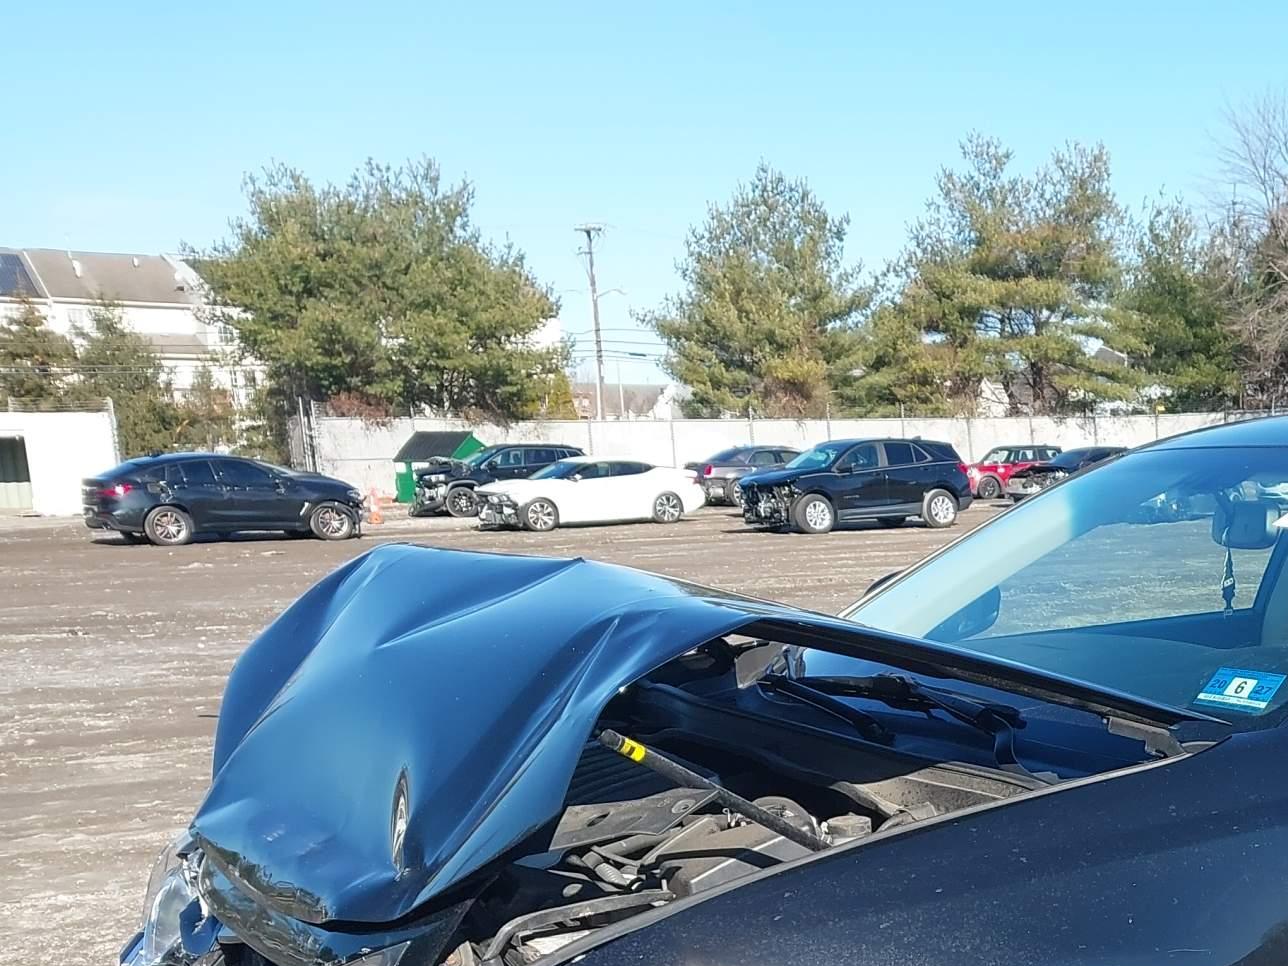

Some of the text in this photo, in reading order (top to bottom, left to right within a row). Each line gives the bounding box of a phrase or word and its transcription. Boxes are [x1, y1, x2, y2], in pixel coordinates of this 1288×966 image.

[1210, 679, 1274, 696] 20 6 27
